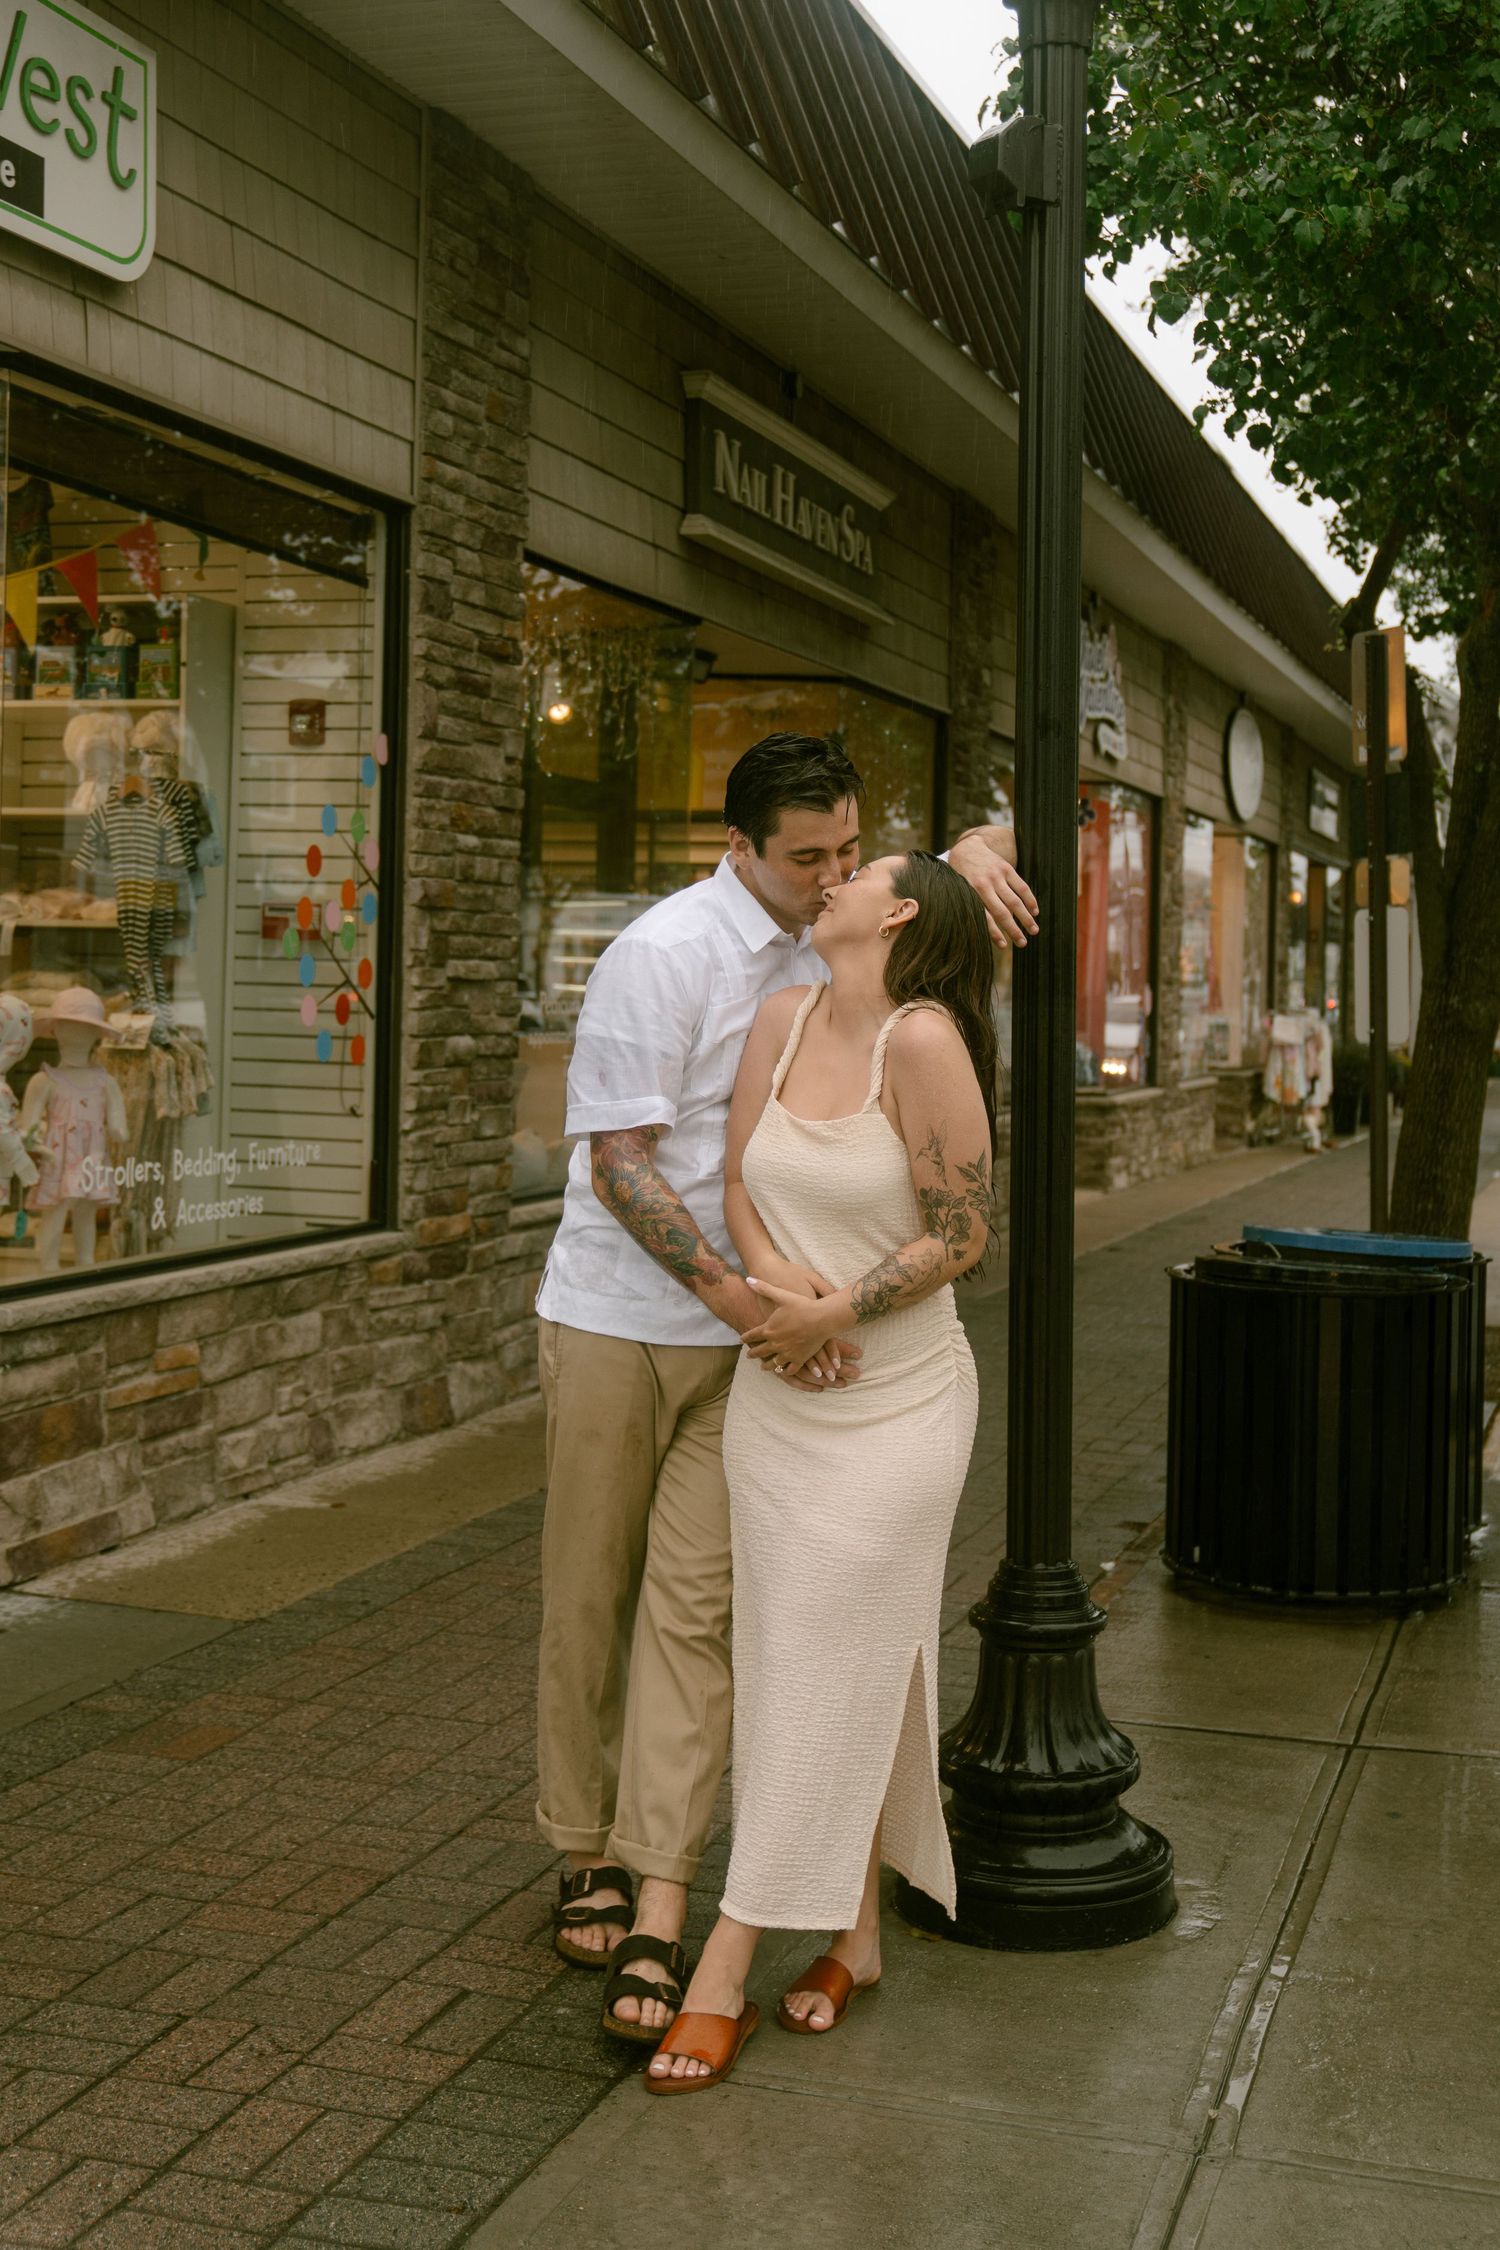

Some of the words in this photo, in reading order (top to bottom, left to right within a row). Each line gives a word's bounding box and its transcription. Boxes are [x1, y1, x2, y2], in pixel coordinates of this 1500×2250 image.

[80, 1155, 165, 1192] Strollers,
[172, 1146, 240, 1184] Bedding,
[248, 1140, 321, 1173] Furniture
[151, 1196, 167, 1230] &
[175, 1195, 264, 1227] Accessories
